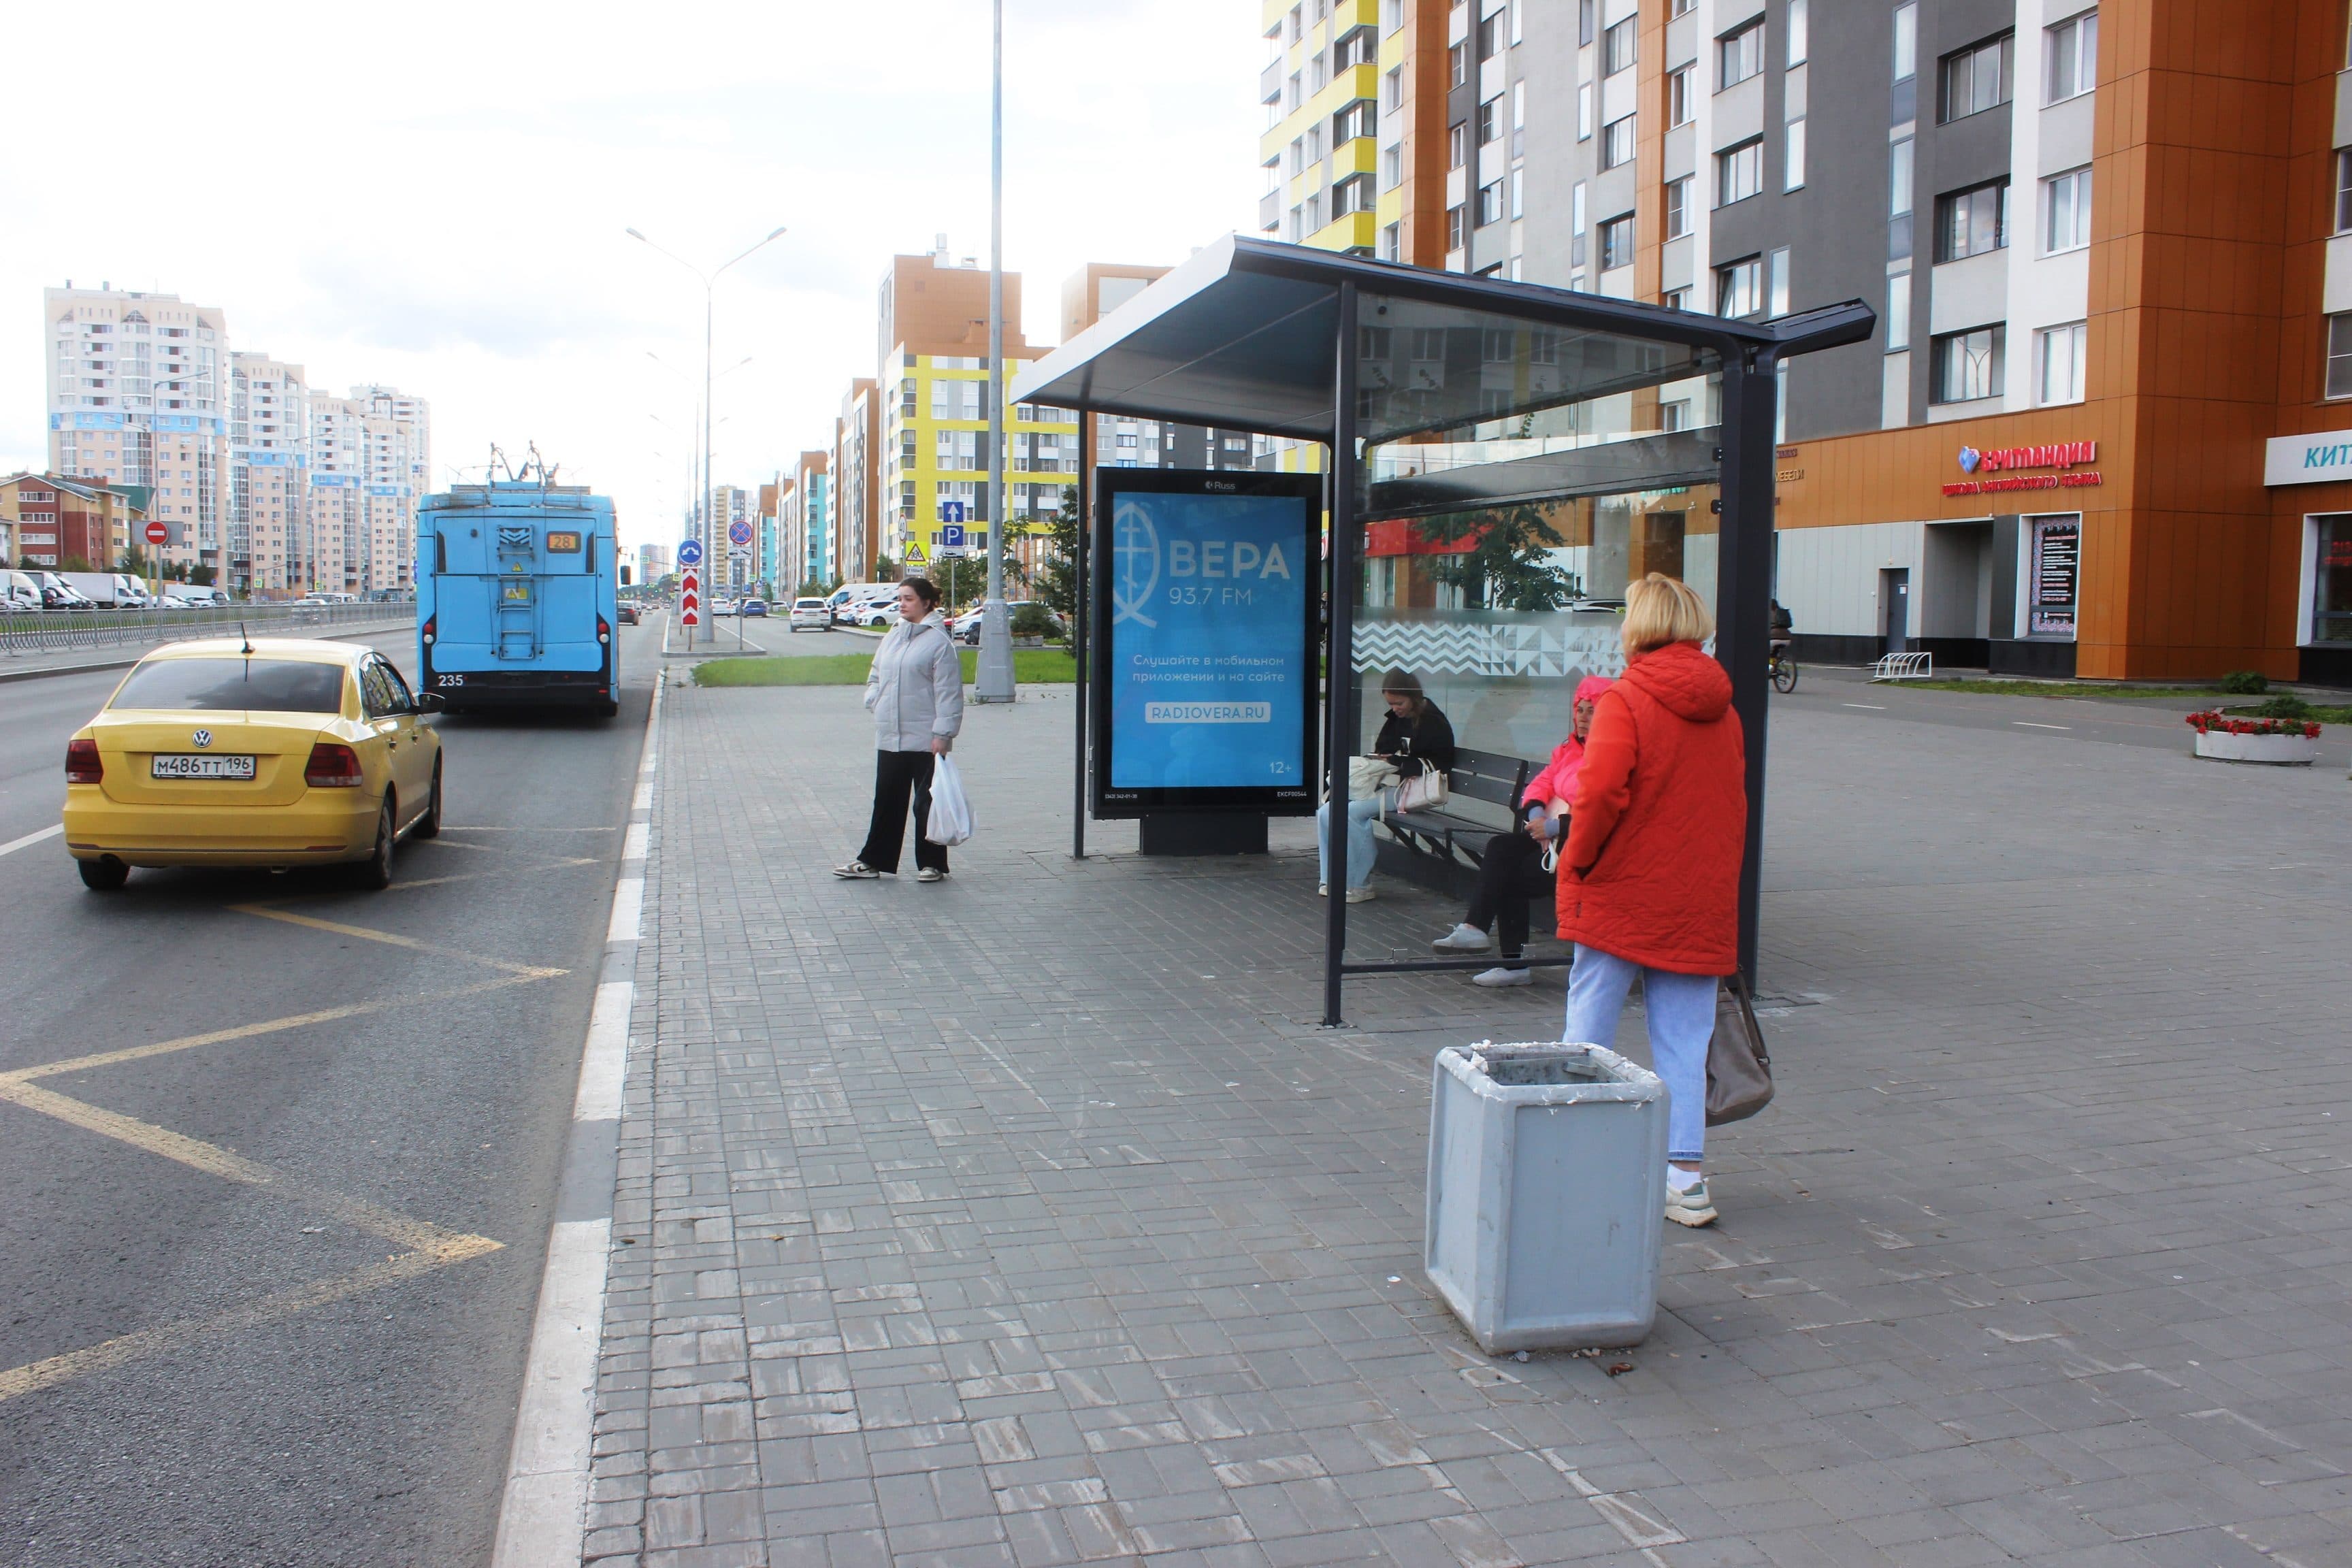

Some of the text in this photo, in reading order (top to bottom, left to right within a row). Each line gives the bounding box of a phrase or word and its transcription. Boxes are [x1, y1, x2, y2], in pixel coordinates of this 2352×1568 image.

[1980, 441, 2096, 471] БРИТЛАНДИЯ
[2304, 444, 2352, 468] КИТ
[1214, 481, 1236, 489] Russ
[1942, 481, 1980, 497] ШКОЛА
[2061, 472, 2102, 488] ЯЗЫКА
[555, 536, 571, 548] 28
[947, 527, 960, 544] P
[1169, 540, 1291, 579] ВЕРА
[1169, 587, 1252, 606] 93.7 FM
[1133, 655, 1200, 668] Слушайте
[1215, 655, 1284, 666] мобильном
[438, 674, 463, 686] 235
[1132, 673, 1214, 683] приложении
[1248, 672, 1285, 682] сайте
[1152, 706, 1264, 719] RADIOVERA.RU
[225, 757, 249, 770] 196
[1269, 762, 1292, 773] 12+
